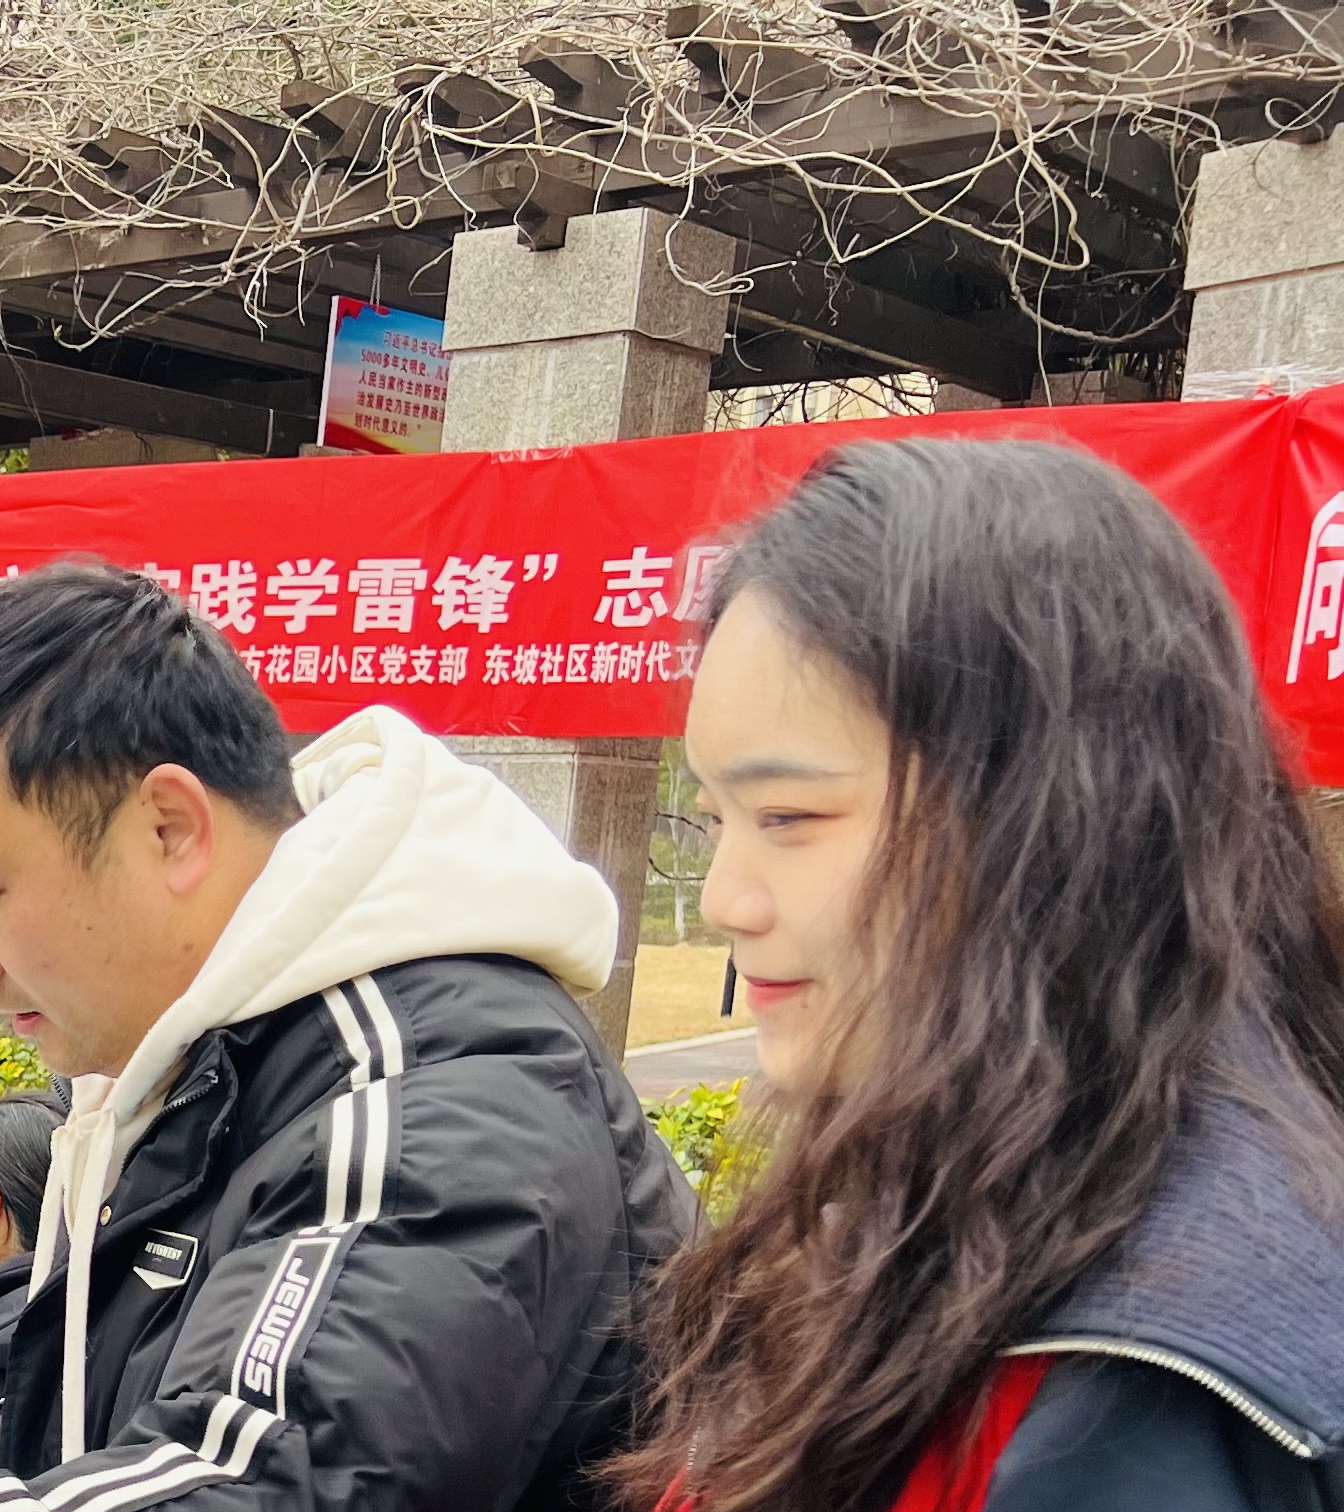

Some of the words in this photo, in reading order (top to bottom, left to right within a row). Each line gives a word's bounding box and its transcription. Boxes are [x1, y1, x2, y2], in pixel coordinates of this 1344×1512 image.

[482, 638, 698, 685] 东坡社区新时代文
